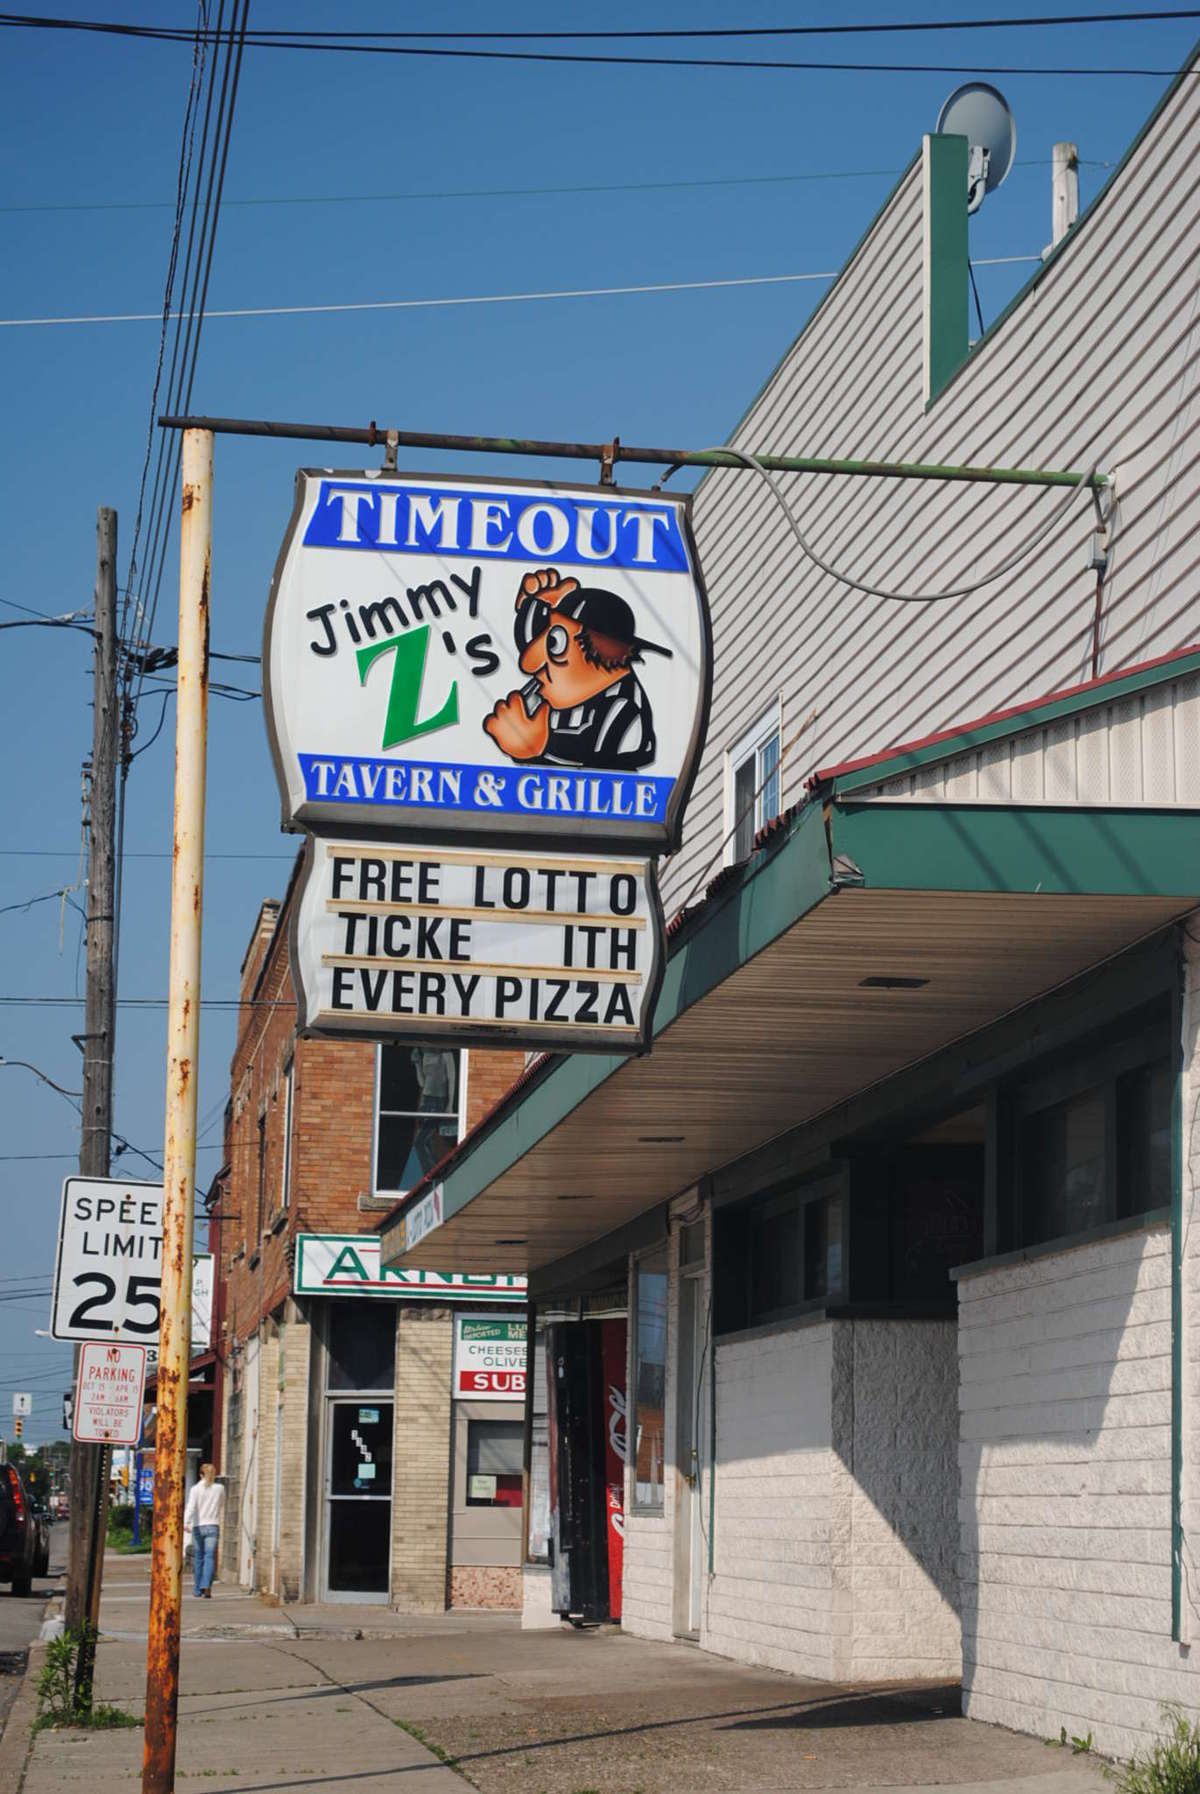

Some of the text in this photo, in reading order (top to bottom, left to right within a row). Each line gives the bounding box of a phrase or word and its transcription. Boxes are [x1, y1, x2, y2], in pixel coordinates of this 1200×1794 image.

[327, 488, 669, 563] TIMEOUT
[306, 566, 481, 657] Jimmy
[355, 624, 500, 750] Z's
[311, 762, 658, 818] TAVERN & GRILLE
[331, 857, 637, 916] FREE LOTTO
[338, 912, 637, 971] TICKE ITH
[331, 967, 635, 1025] EVERY PIZZA
[74, 1197, 163, 1226] SPEE
[82, 1231, 163, 1260] LIMIT
[68, 1272, 161, 1334] 25
[88, 1366, 135, 1383] PARKING
[106, 1348, 121, 1364] NO
[473, 1373, 526, 1391] SUB
[88, 1407, 129, 1418] VIOLATORS
[93, 1418, 123, 1428] WILL BE
